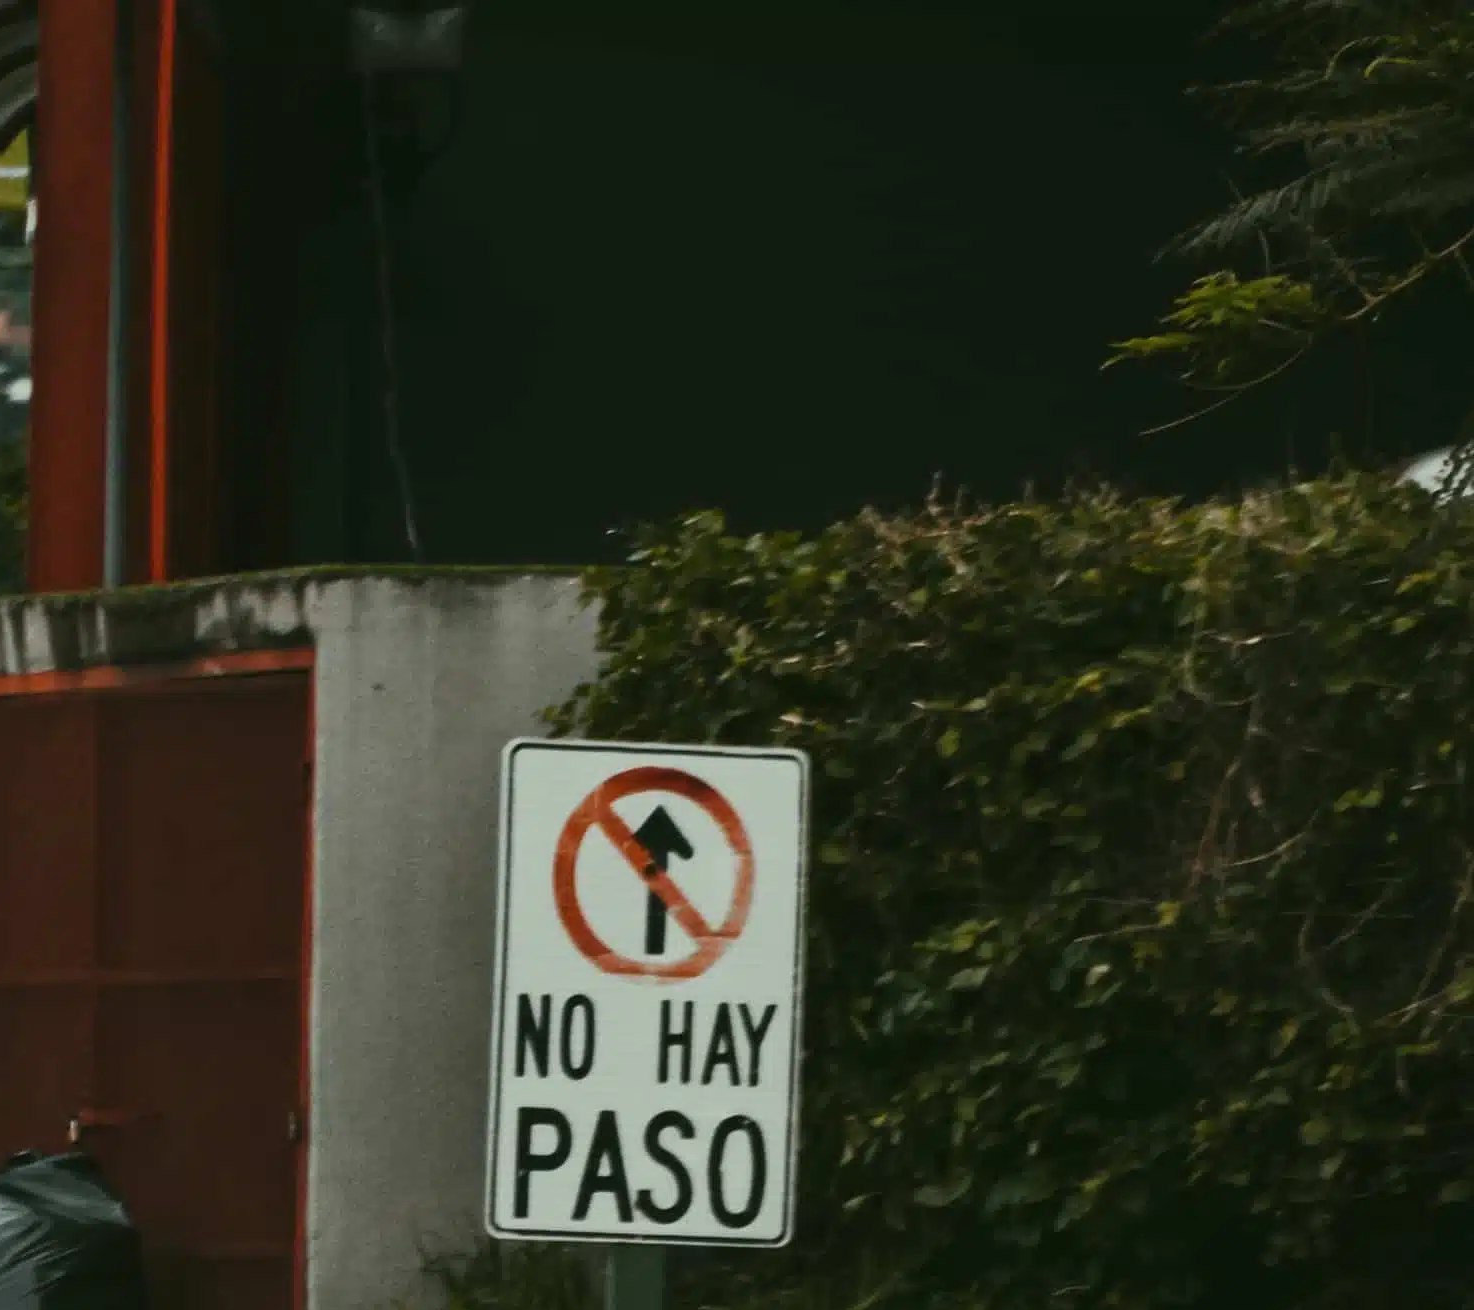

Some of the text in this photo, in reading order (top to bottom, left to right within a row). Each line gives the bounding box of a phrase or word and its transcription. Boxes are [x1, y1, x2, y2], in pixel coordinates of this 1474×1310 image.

[513, 993, 779, 1087] NO HAY
[512, 1106, 768, 1229] PASO
